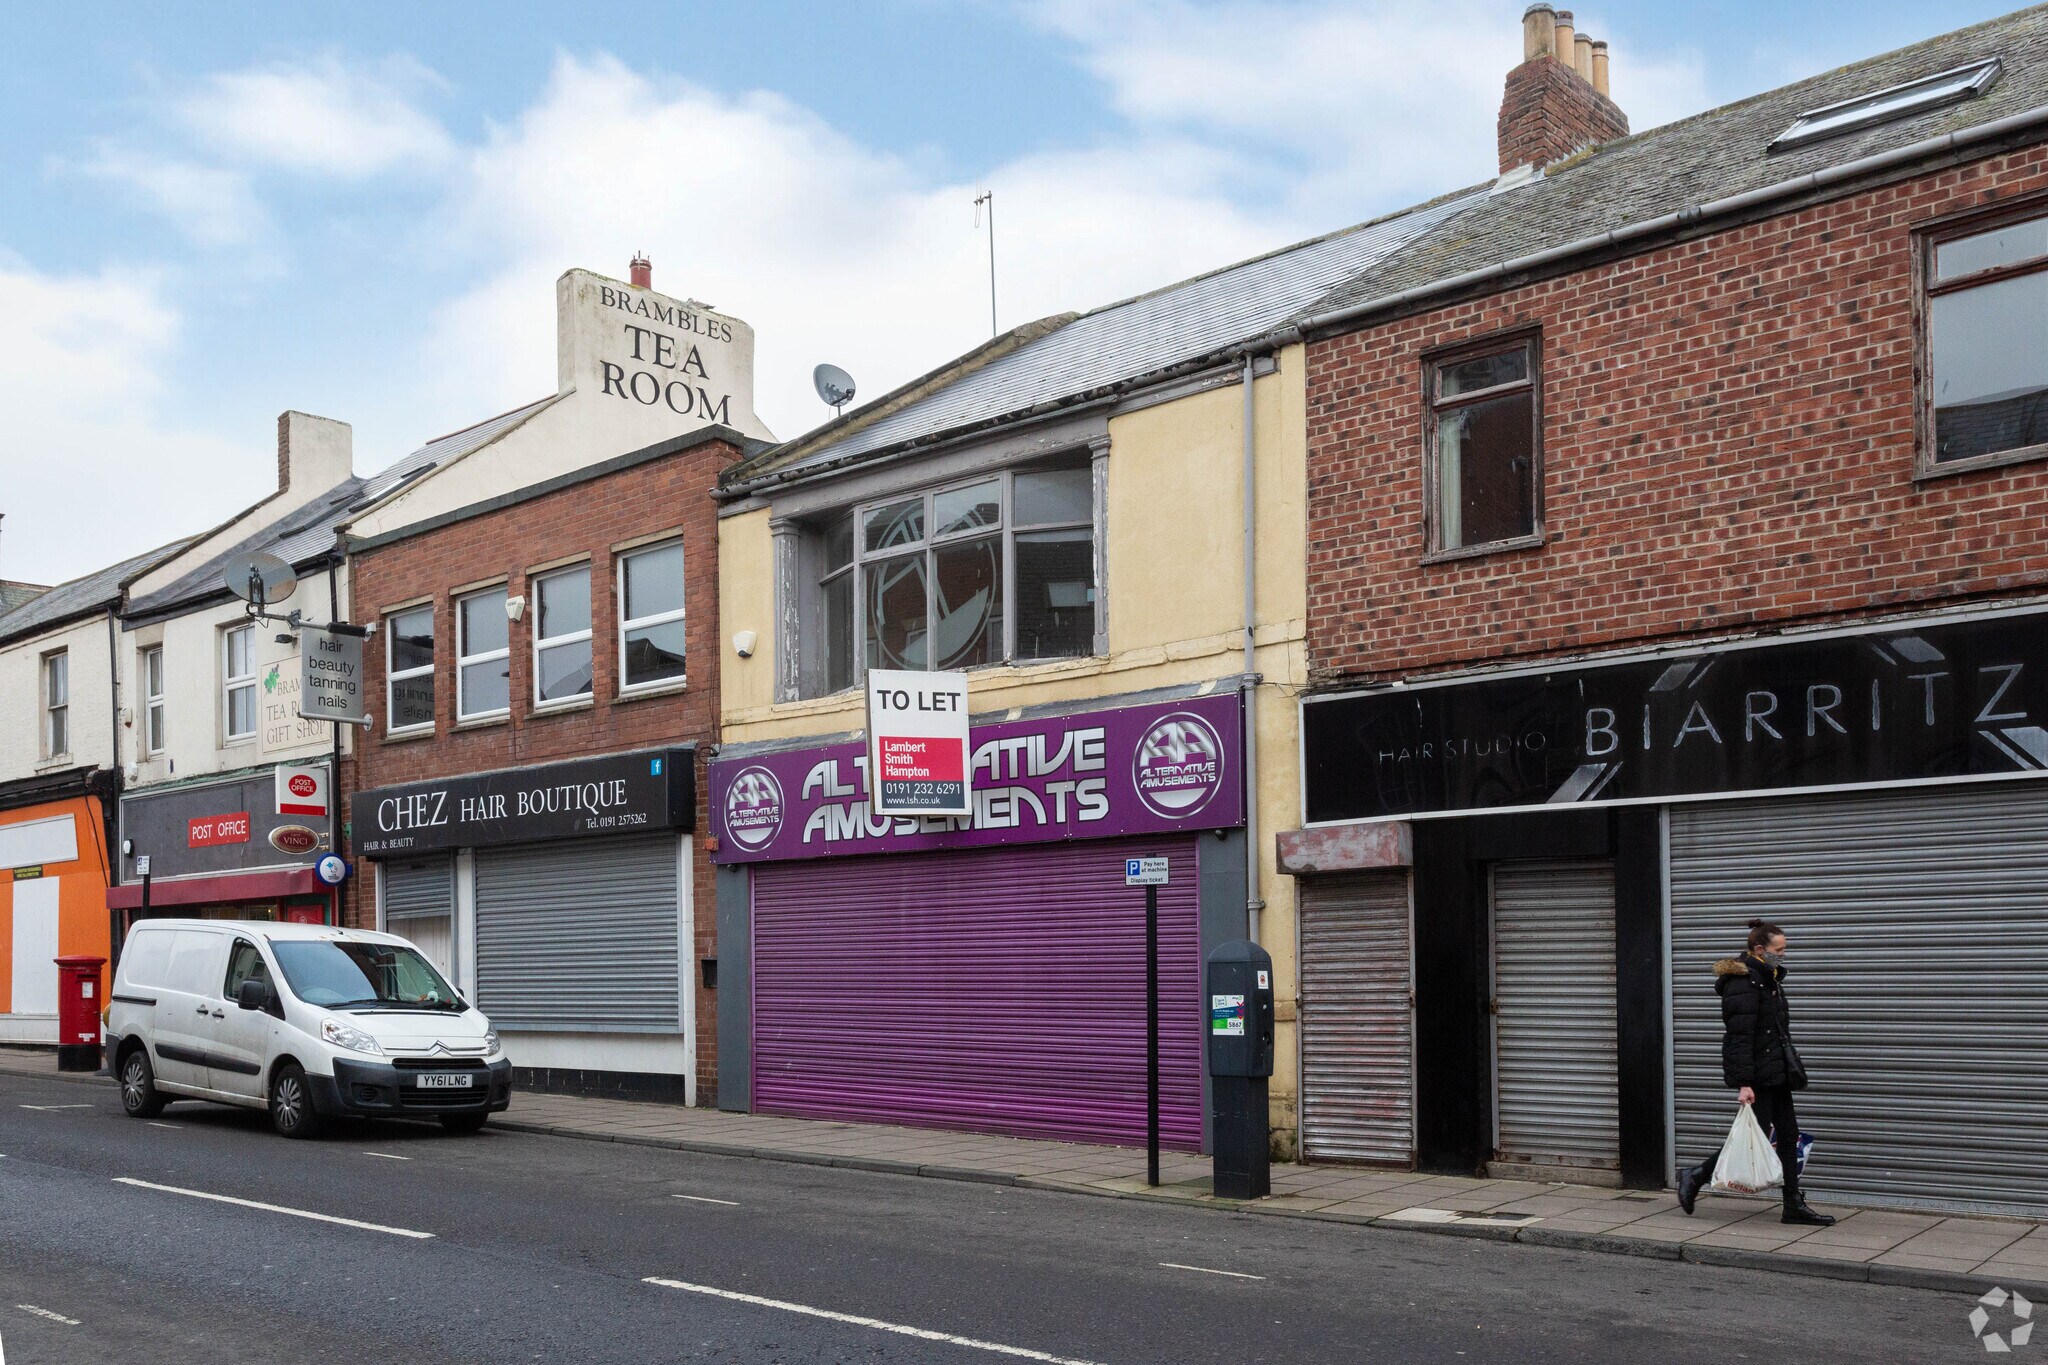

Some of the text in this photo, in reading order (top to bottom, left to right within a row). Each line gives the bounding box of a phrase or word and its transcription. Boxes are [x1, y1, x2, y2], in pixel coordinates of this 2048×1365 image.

[600, 285, 732, 343] BRAMBLES
[624, 324, 710, 380] TEA
[600, 360, 732, 426] ROOM
[320, 638, 344, 653] hair
[309, 656, 355, 677] beauty
[309, 675, 356, 695] tanning
[318, 695, 347, 709] nails
[877, 690, 961, 712] TO LET
[266, 704, 286, 721] TEA
[1586, 663, 2027, 756] BIARRITZ
[267, 719, 325, 745] GIFT SHOP
[885, 740, 926, 753] Lambert
[1379, 731, 1546, 765] HAIR STUDIO
[801, 727, 1105, 800] ALTATIVE
[885, 753, 913, 765] Smith
[886, 765, 930, 779] Hampton
[1140, 762, 1215, 778] ALTERNATIVE
[291, 784, 314, 793] OFFICE
[294, 779, 311, 787] POST
[886, 783, 961, 794] 0191 232 6291
[1140, 772, 1216, 789] AMUSEMENTS
[378, 779, 628, 832] CHEZ HAIR BOUTIQUE
[886, 796, 941, 805] www.lsh.co.uk
[729, 806, 779, 819] ALTERNATIVE
[586, 817, 599, 829] Tel.
[599, 816, 616, 828] 0191
[729, 815, 780, 827] AMUSEMENTS
[192, 820, 246, 840] POST OFFICE
[283, 837, 308, 846] VINCI
[363, 837, 415, 851] HAIR & BEAUTY
